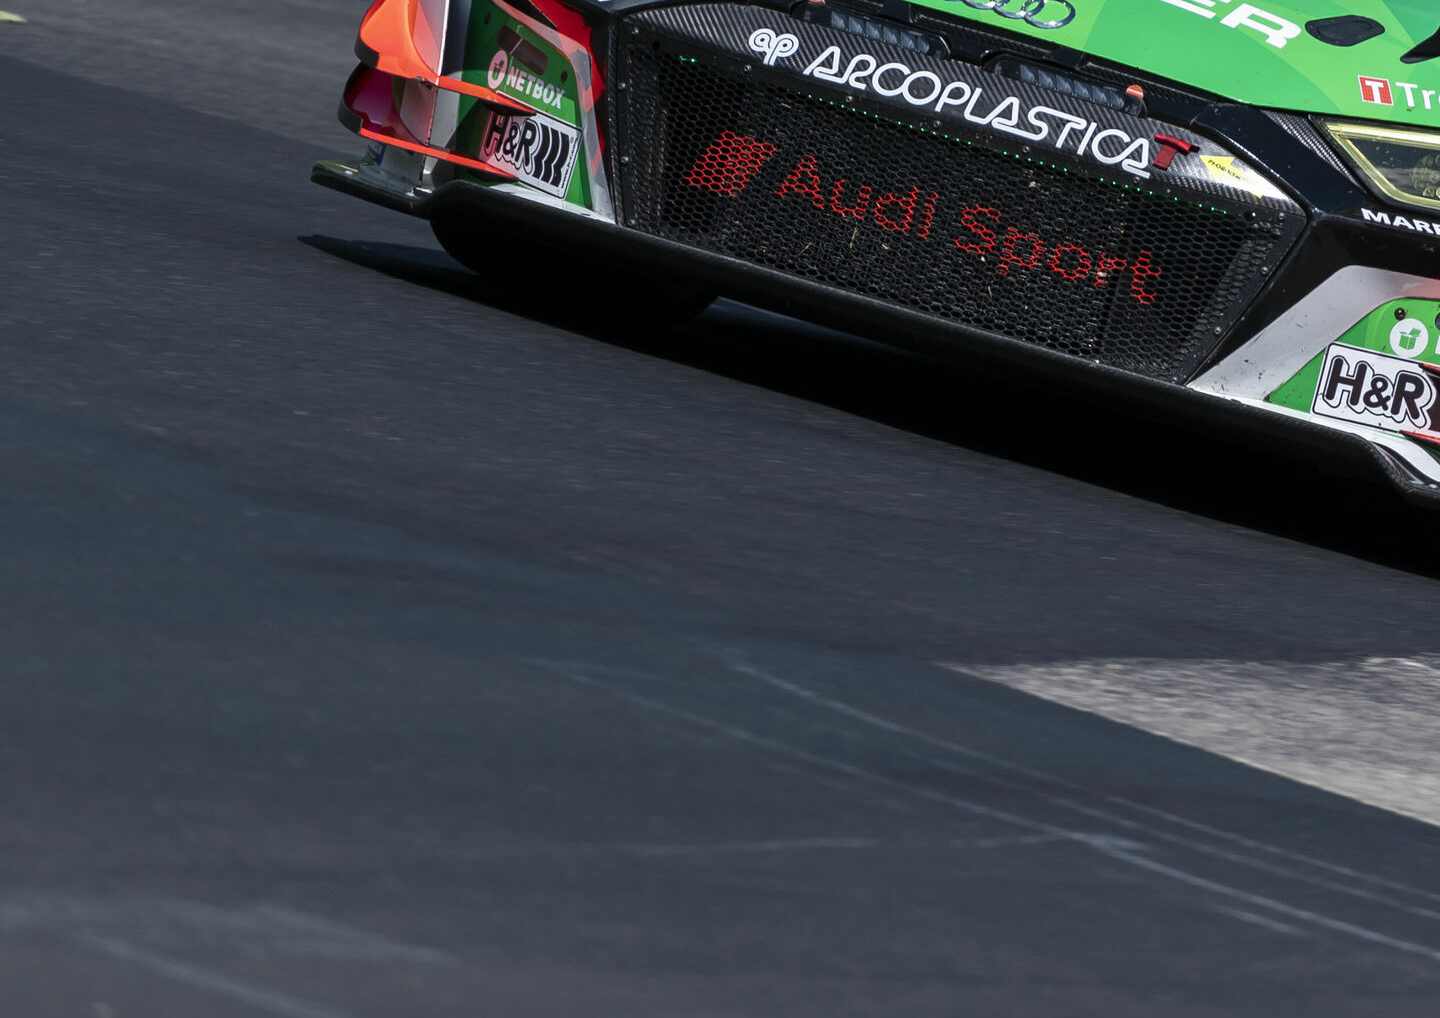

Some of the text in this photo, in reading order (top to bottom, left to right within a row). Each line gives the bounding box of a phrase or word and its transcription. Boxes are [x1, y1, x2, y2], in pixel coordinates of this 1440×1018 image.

[505, 65, 566, 110] NETBOX
[803, 45, 1154, 180] ARCOPLASTICA
[484, 111, 540, 170] H&R
[774, 153, 1163, 305] Audi Sport
[1322, 356, 1429, 425] H&R
